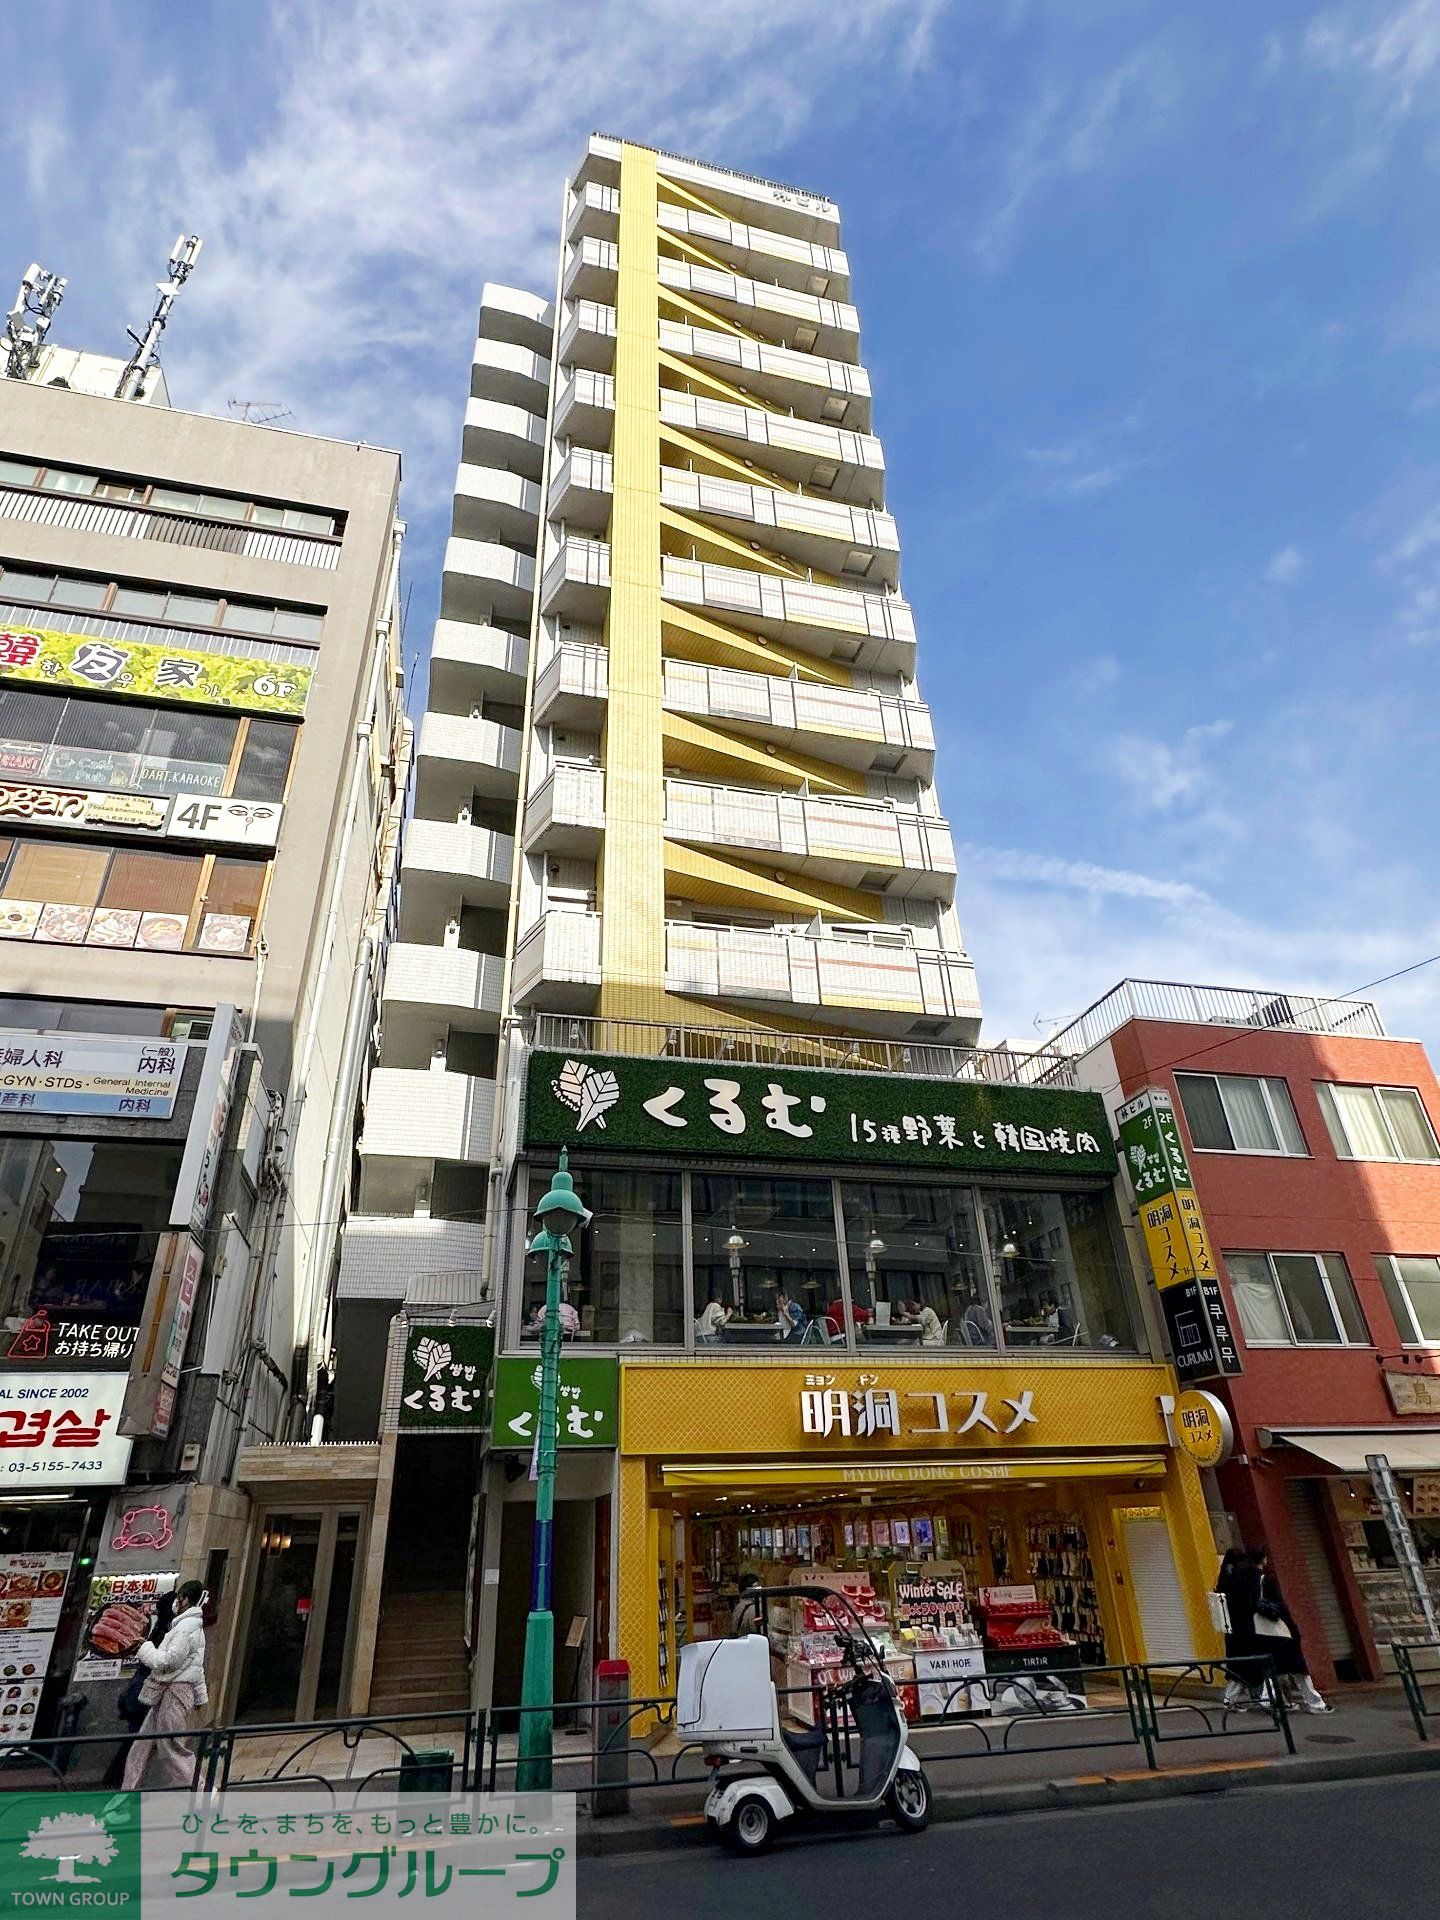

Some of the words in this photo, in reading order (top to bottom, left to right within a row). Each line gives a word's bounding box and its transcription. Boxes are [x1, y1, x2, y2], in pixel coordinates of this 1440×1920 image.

[253, 673, 298, 698] 6F
[177, 803, 222, 830] 4F
[0, 1048, 63, 1068] 婦人科
[137, 1057, 176, 1075] 内科
[93, 1077, 131, 1087] General
[135, 1079, 171, 1089] Internal
[125, 1086, 169, 1097] Medicine
[118, 1099, 151, 1113] 内科
[642, 1079, 826, 1138] くるむ
[1142, 1115, 1153, 1130] 2F
[1158, 1113, 1173, 1123] 2F
[1164, 1131, 1188, 1182] くるむ
[1135, 1166, 1166, 1191] くるむ
[1146, 1204, 1173, 1229] 明洞
[1159, 1227, 1180, 1280] コスメ
[1185, 1286, 1197, 1298] B1F
[1203, 1286, 1218, 1296] B1F
[58, 1322, 103, 1340] TAKE
[105, 1326, 140, 1342] OUT
[1209, 1303, 1236, 1364] 쿠루무
[55, 1340, 133, 1359] お持ち帰り
[17, 1388, 57, 1399] SINCE
[60, 1388, 89, 1399] 2002
[404, 1384, 481, 1412] くるむ
[508, 1404, 604, 1438] くむ
[801, 1388, 1039, 1438] 明洞コスメ
[1182, 1408, 1210, 1428] 明洞
[0, 1408, 112, 1448] 겹살
[8, 1460, 103, 1472] 03-5155-7433
[843, 1467, 903, 1481] MYUNG
[908, 1466, 954, 1480] DONG
[112, 1579, 156, 1593] 日本初
[899, 1583, 936, 1599] Winter
[936, 1581, 964, 1600] SALE
[930, 1660, 950, 1669] VARI
[1023, 1656, 1048, 1666] TIRTIR
